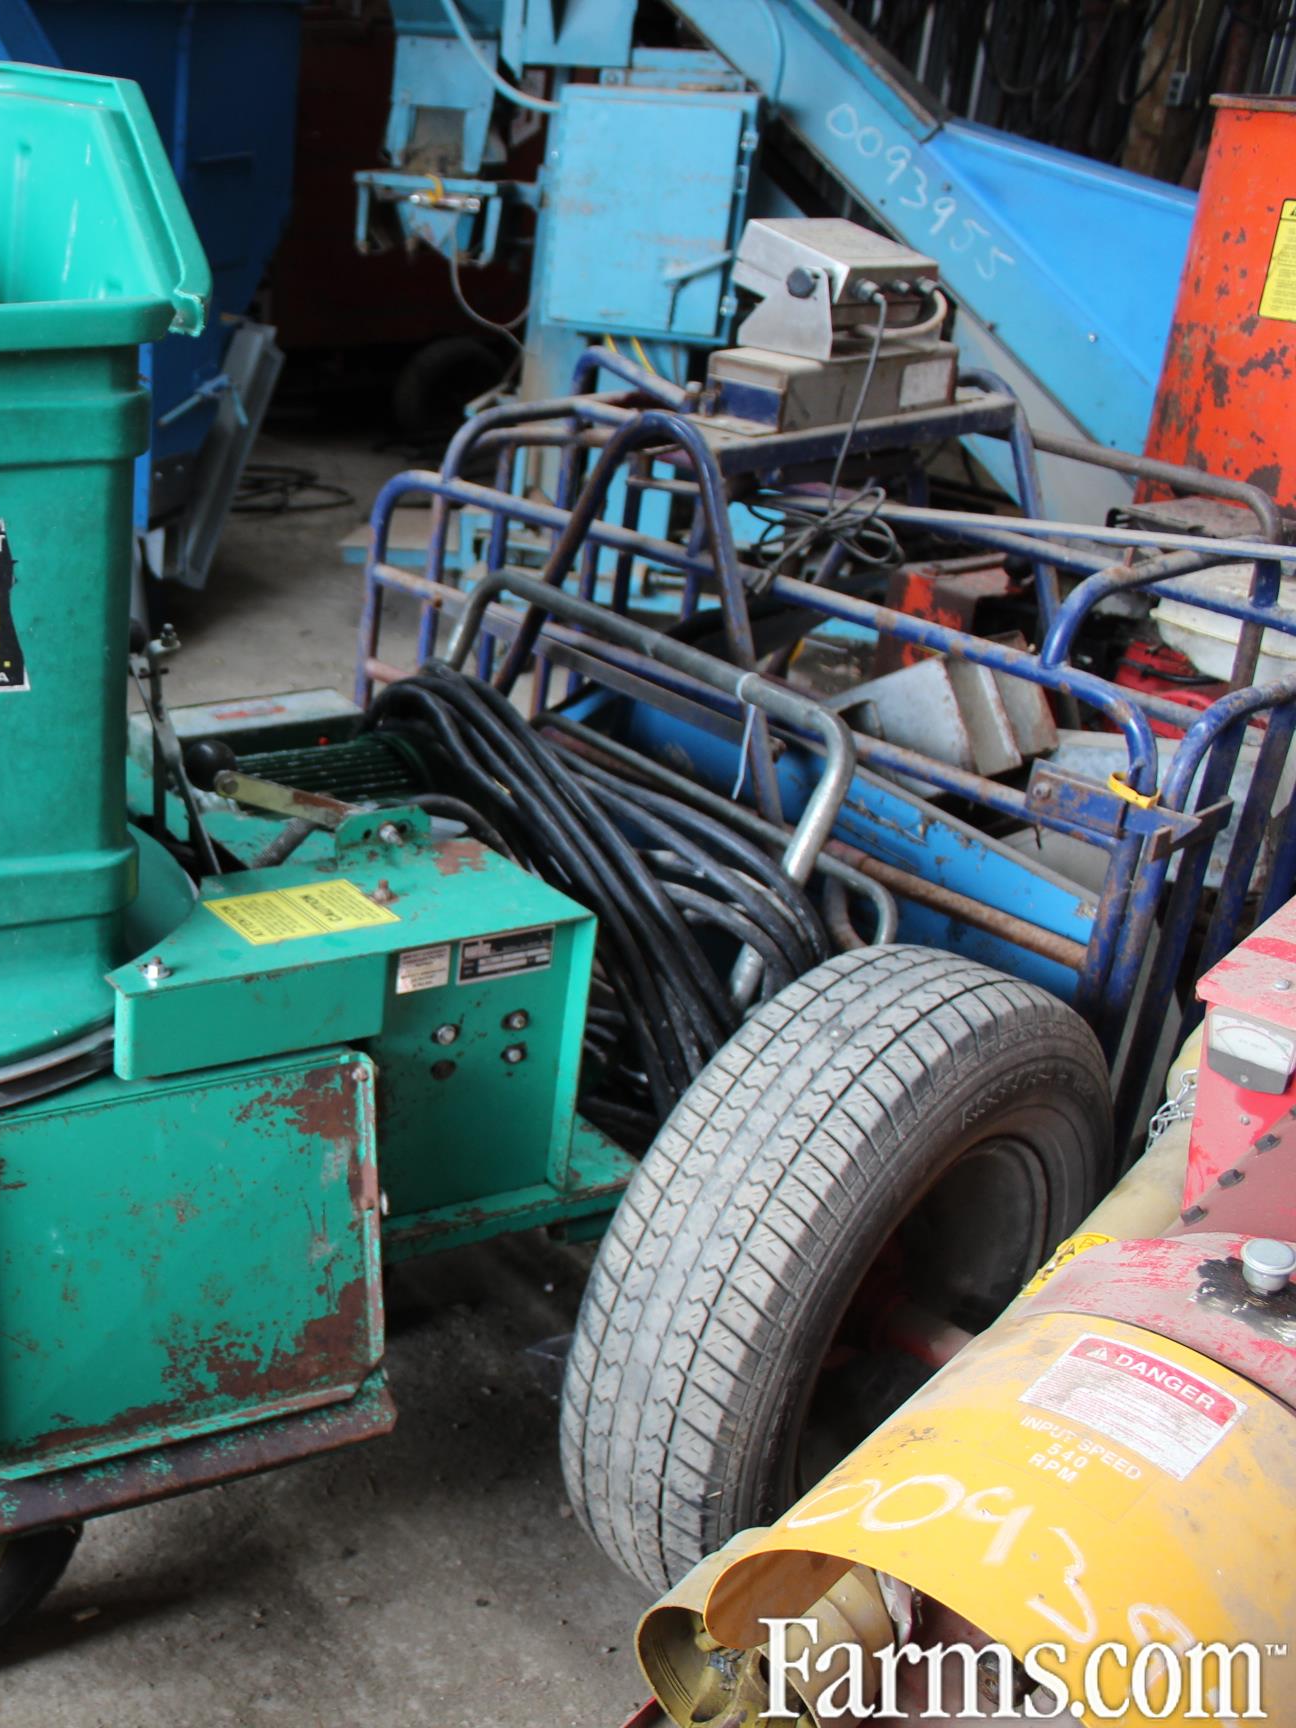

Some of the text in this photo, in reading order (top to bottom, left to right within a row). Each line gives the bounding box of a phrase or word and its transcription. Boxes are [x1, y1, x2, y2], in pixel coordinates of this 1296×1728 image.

[826, 103, 1016, 280] 0093955
[1114, 1353, 1216, 1411] DANGER
[1019, 1415, 1143, 1481] INPUT SPEED
[1027, 1453, 1079, 1483] RPM
